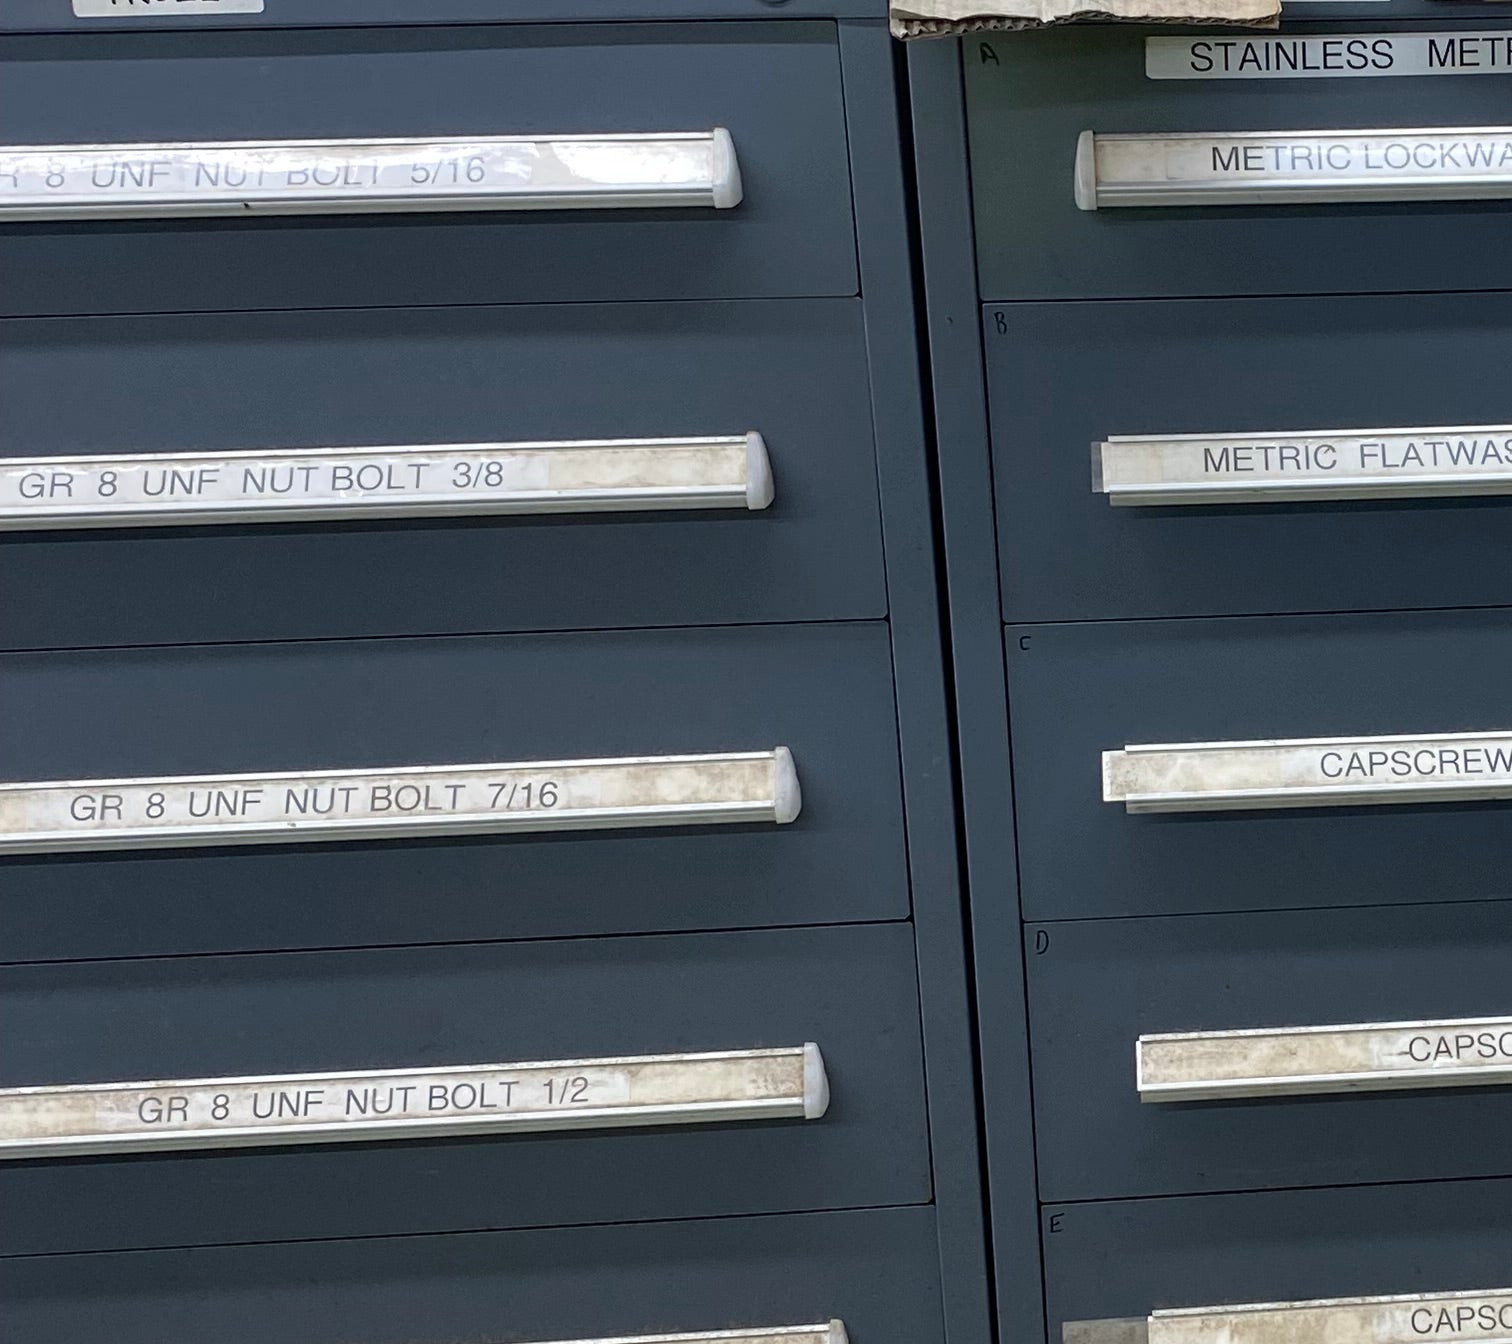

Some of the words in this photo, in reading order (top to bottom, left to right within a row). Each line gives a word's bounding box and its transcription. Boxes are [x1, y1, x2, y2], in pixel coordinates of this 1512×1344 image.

[1189, 38, 1394, 74] STAINLESS
[45, 162, 65, 188] 8
[92, 160, 173, 188] UNF
[410, 156, 486, 184] 5/16
[1210, 138, 1352, 174] METRIC
[1203, 442, 1338, 476] METRIC
[20, 470, 75, 499] GR
[98, 470, 118, 498] 8
[142, 467, 219, 497] UNF
[242, 464, 320, 496] NUT
[330, 461, 431, 492] BOLT
[452, 459, 504, 489] 3/8
[70, 793, 125, 823] GR
[145, 792, 166, 821] 8
[187, 789, 264, 819] UNF
[283, 786, 359, 816] NUT
[370, 783, 468, 814] BOLT
[486, 780, 560, 810] 7/16
[1036, 930, 1050, 955] D
[137, 1096, 191, 1126] GR
[210, 1094, 231, 1122] 8
[251, 1089, 327, 1120] UNF
[344, 1086, 419, 1116] NUT
[427, 1081, 521, 1113] BOLT
[541, 1075, 590, 1106] 1/2
[1050, 1213, 1065, 1234] E
